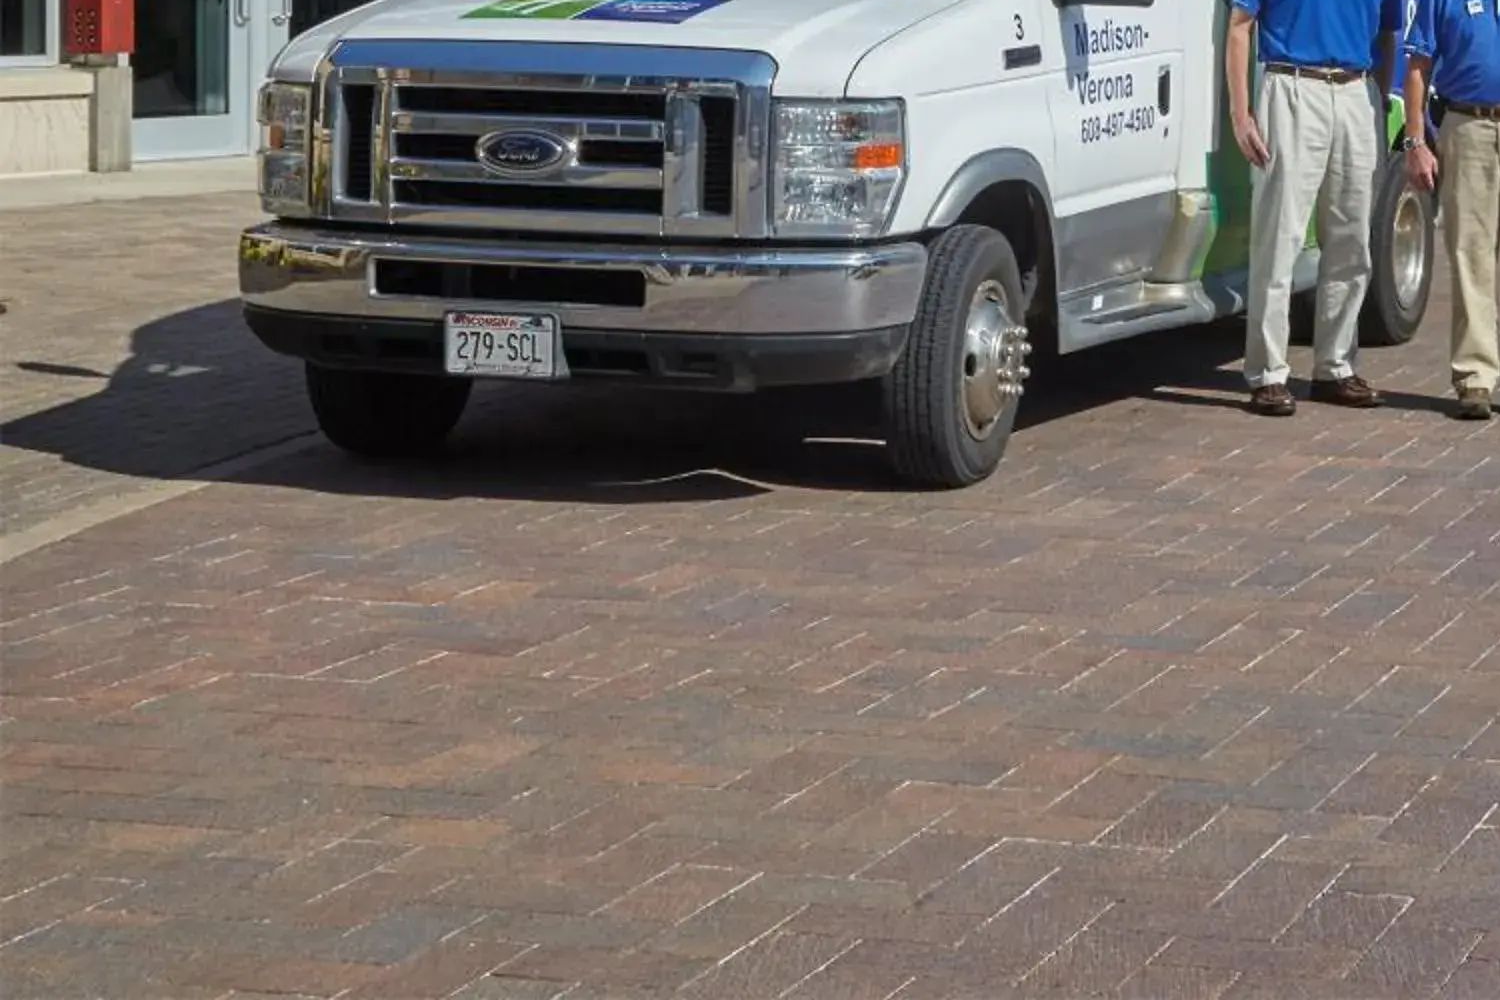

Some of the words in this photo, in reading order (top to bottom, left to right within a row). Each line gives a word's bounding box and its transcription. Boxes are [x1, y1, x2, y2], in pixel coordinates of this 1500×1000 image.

[1013, 13, 1025, 41] 3
[1074, 19, 1150, 56] Madison-
[1075, 71, 1133, 105] Verona
[456, 331, 543, 363] 279-SCL
